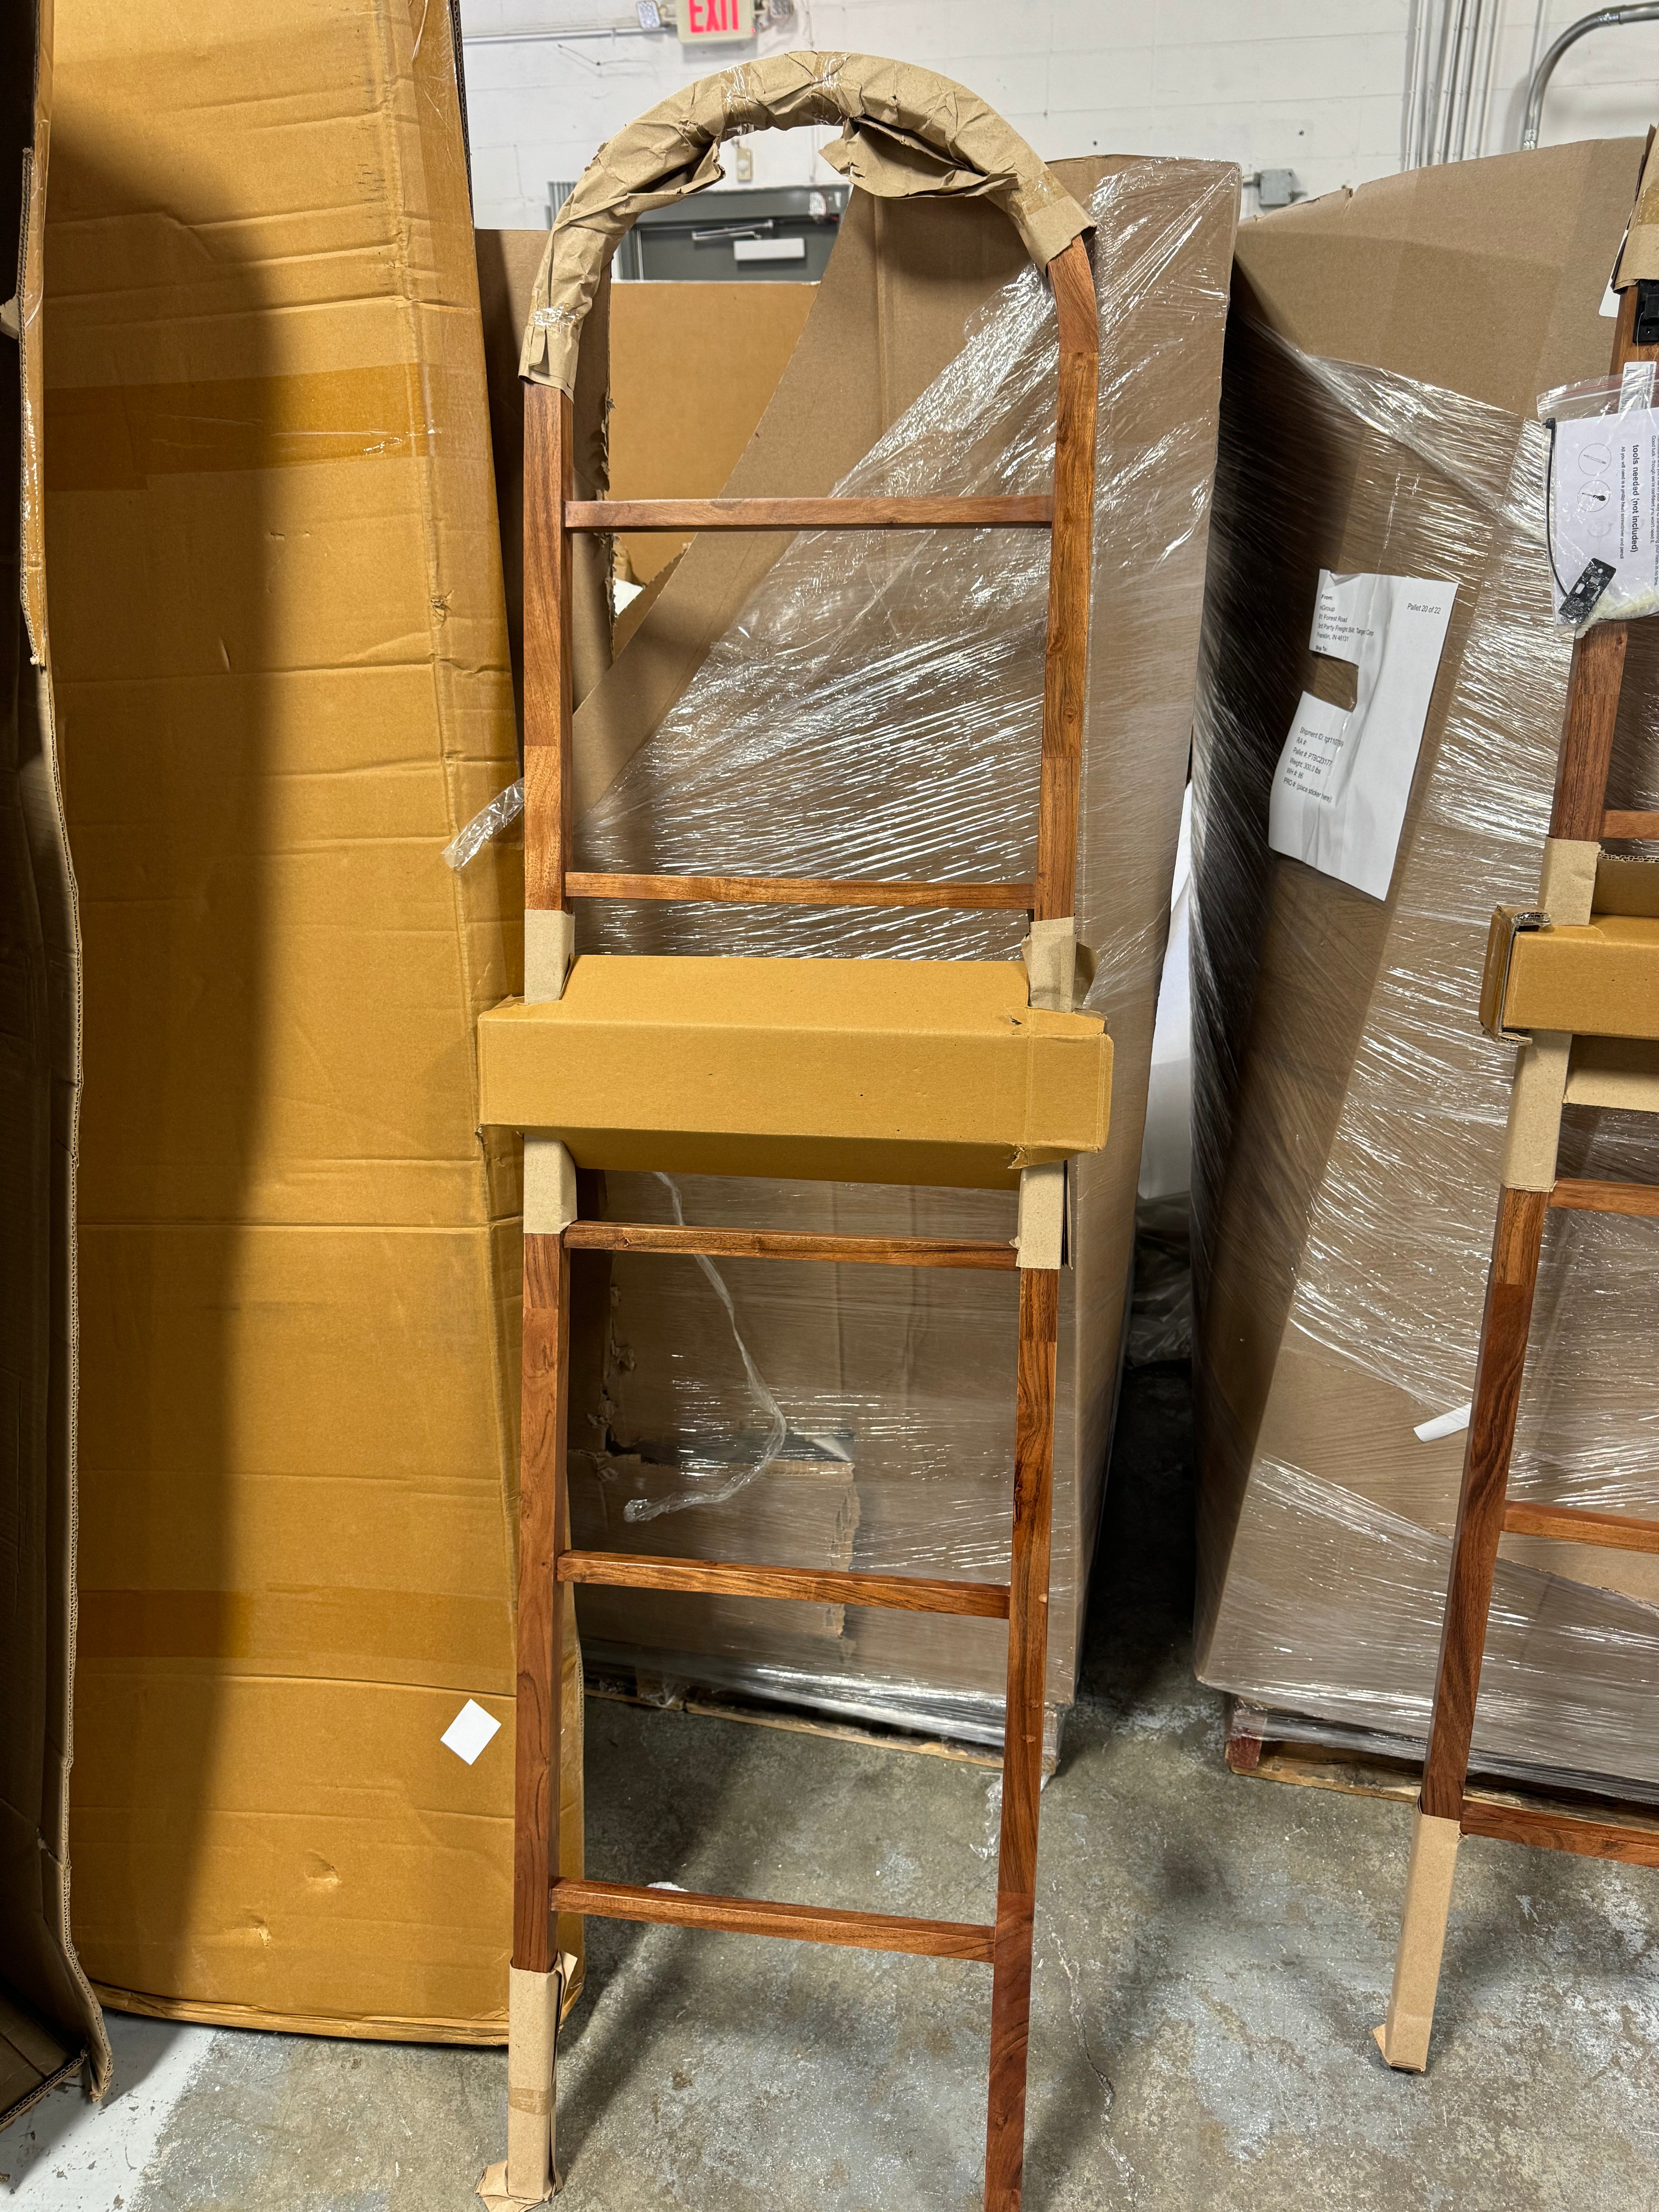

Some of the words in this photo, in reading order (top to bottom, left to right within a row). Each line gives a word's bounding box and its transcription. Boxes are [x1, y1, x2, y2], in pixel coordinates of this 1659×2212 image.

[1631, 498, 1640, 514] (not
[1630, 516, 1639, 552] included)
[1407, 603, 1421, 611] Pallet
[1324, 623, 1335, 632] Party
[1335, 625, 1348, 633] Freight
[1300, 727, 1318, 738] Shipment
[1293, 747, 1304, 756] Pallet
[1283, 777, 1293, 786] PRO
[1308, 789, 1321, 797] sticker
